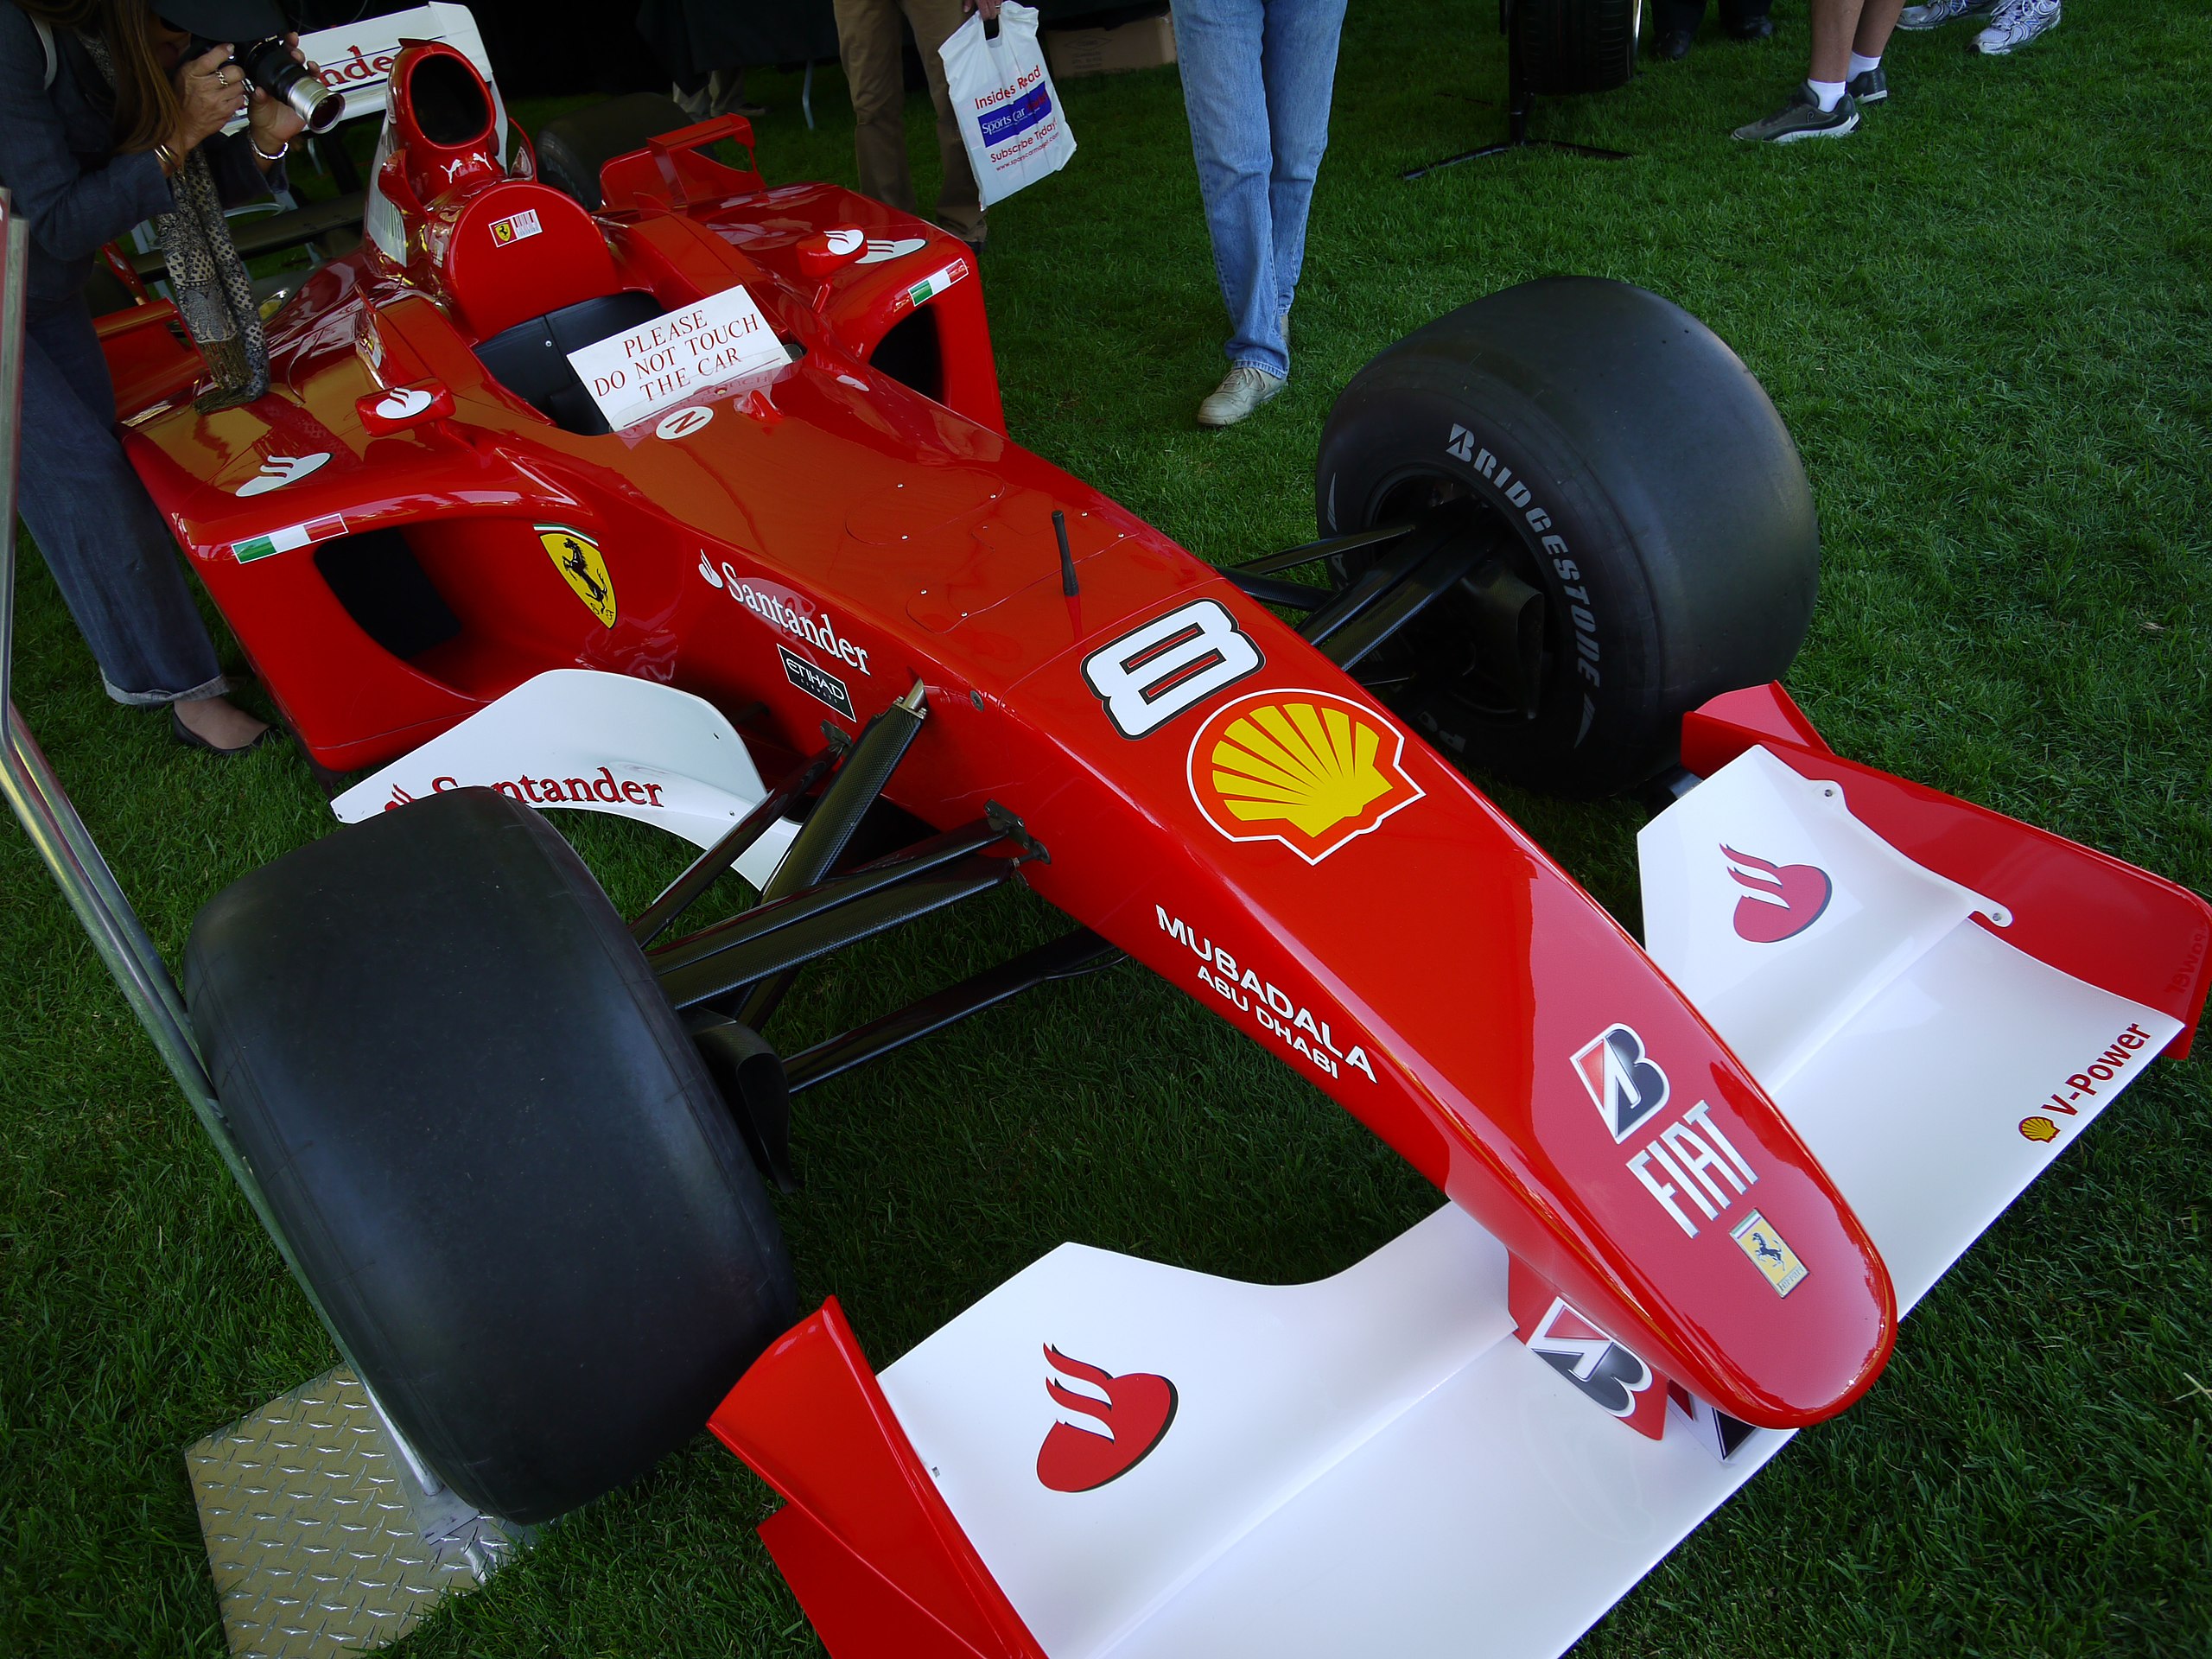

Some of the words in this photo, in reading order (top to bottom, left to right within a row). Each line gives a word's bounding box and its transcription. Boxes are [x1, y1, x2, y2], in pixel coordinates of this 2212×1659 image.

[1017, 65, 1041, 89] Read
[982, 114, 1012, 136] Sports
[990, 137, 1034, 162] Subscrbe
[594, 370, 626, 397] DO
[634, 346, 677, 380] NOT
[684, 313, 760, 357] TOUCH
[623, 309, 709, 359] PLEASE
[639, 367, 691, 403] THE
[697, 347, 741, 377] CAR
[1446, 423, 1601, 688] BRIDGESTONE
[721, 561, 872, 677] Santander
[785, 658, 846, 701] ETIHAD
[1080, 597, 1266, 741] 8
[431, 767, 664, 808] Sntander
[1156, 904, 1378, 1085] MUBADALA
[1197, 965, 1249, 1013] ABU
[1255, 1005, 1338, 1080] DHABI
[2040, 1023, 2152, 1117] V-Power
[1625, 1099, 1760, 1240] FIAT
